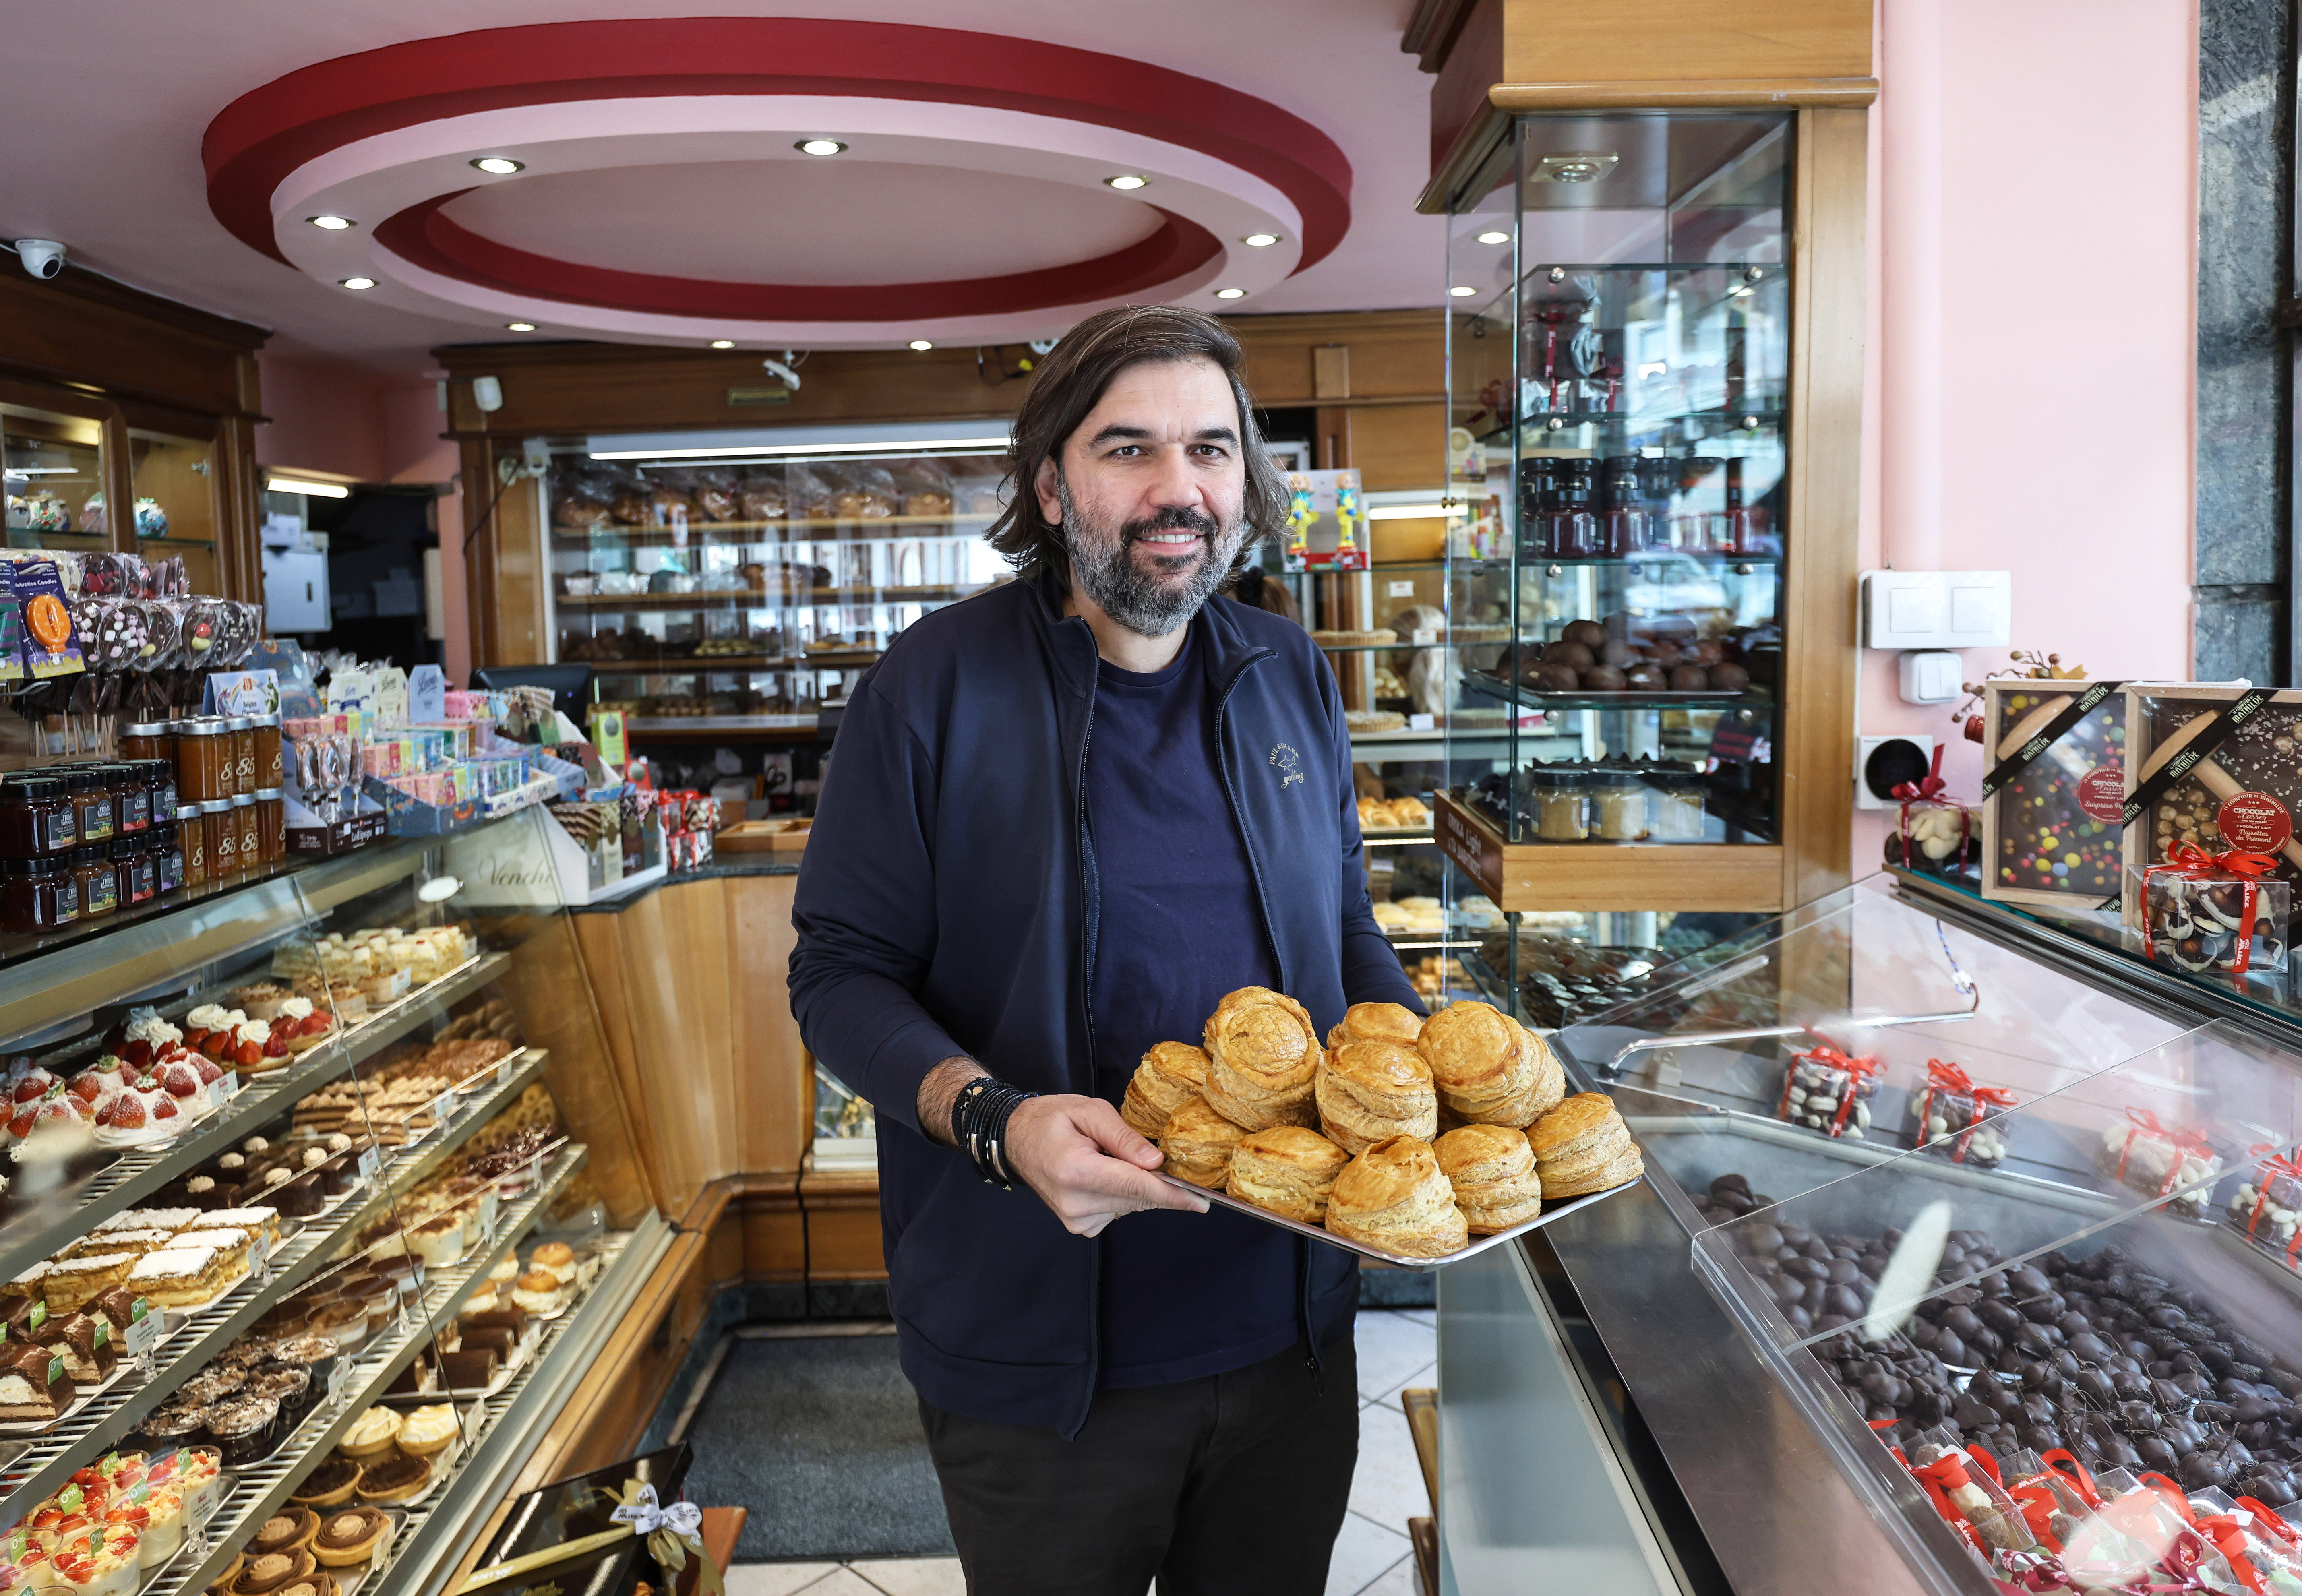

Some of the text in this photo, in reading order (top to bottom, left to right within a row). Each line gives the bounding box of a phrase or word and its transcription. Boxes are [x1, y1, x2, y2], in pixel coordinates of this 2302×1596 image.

[2080, 686, 2109, 711] MATHILDE
[2236, 699, 2250, 712] COMPTOIR
[2232, 695, 2263, 723] MATHILDE
[1269, 748, 1279, 765] PAUL
[1281, 743, 1299, 759] SHARK
[2022, 737, 2050, 761] MATHILDE
[2170, 750, 2199, 777] MATHILDE
[2172, 755, 2186, 768] COMPTOIR
[1281, 769, 1305, 788] yachting
[2087, 768, 2110, 779] COMPTOIR
[2085, 801, 2113, 809] Surprise
[2228, 794, 2252, 806] COMPTOIR
[2260, 795, 2285, 814] MATHILDE
[2236, 938, 2246, 966] MIKE
[31, 1306, 44, 1318] 0%
[133, 1302, 146, 1313] 0%
[103, 1456, 116, 1470] 0%
[178, 1452, 190, 1464] 0%
[2018, 1475, 2047, 1489] MIKE
[61, 1488, 78, 1503] 0%
[130, 1484, 146, 1498] 0%
[12, 1535, 25, 1549] 0%
[91, 1532, 102, 1544] 0%
